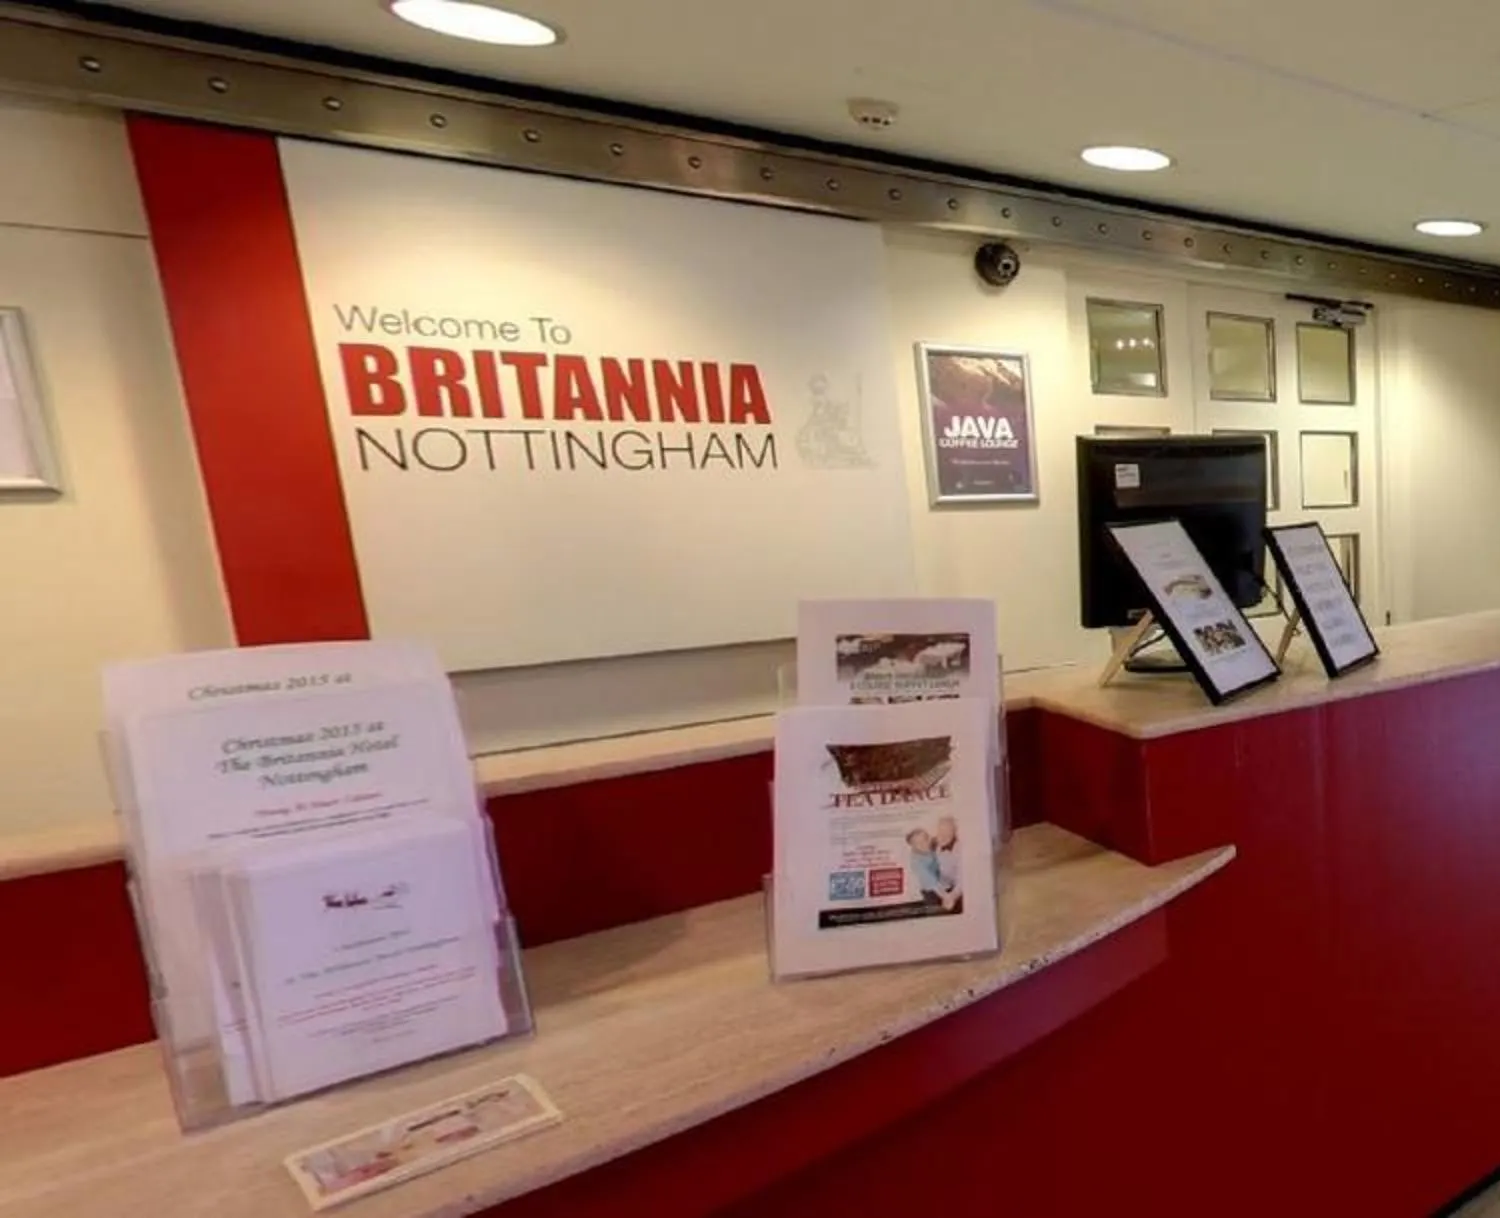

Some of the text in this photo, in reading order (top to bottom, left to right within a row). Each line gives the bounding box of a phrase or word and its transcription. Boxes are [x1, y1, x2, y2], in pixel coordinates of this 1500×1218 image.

[333, 303, 572, 346] Welcome To
[337, 343, 772, 425] BRITANNIA
[944, 415, 1014, 438] JAVA
[355, 427, 779, 472] NOTTINGHAM
[286, 673, 330, 691] 2015
